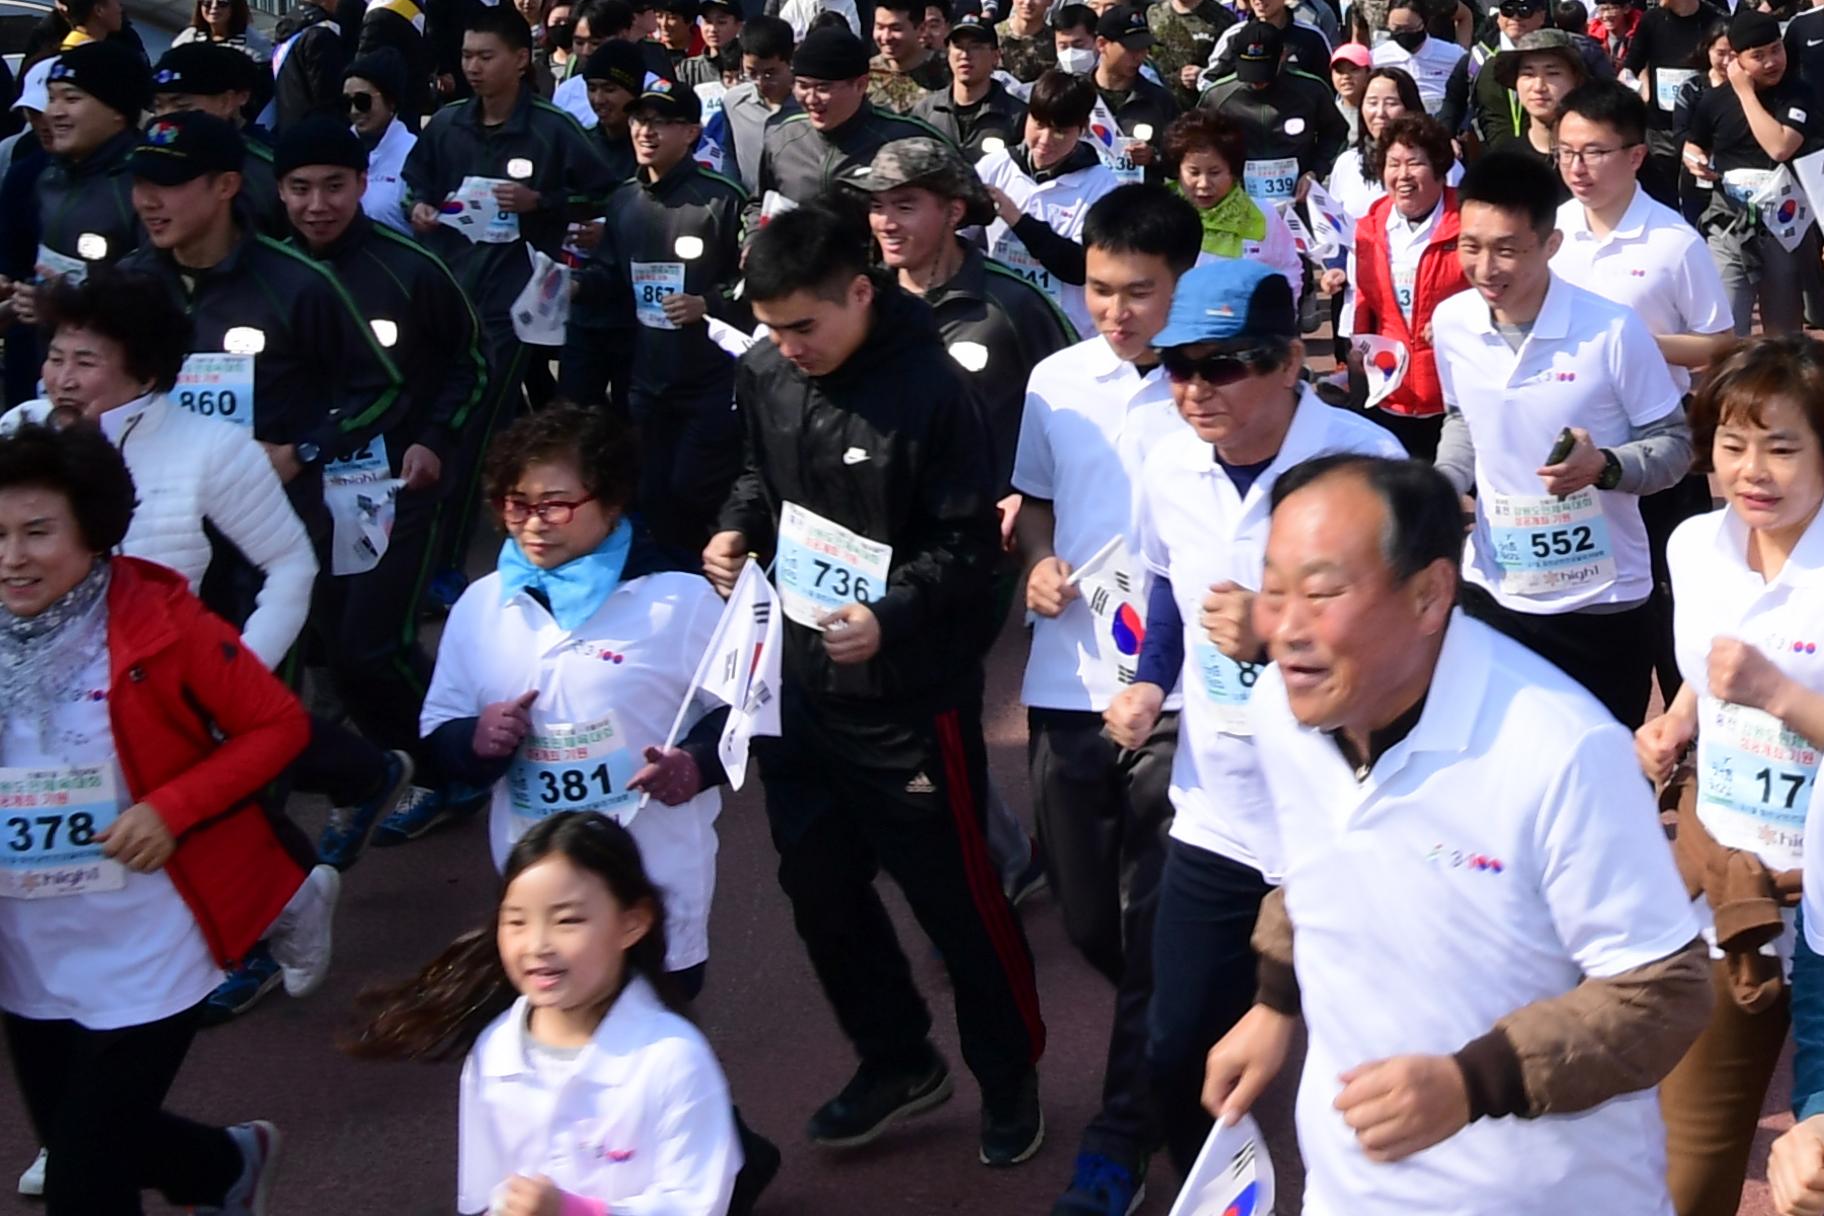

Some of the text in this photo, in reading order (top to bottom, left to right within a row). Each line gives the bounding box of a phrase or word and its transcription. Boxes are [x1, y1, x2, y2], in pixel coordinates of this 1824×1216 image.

[179, 390, 237, 416] 860
[1530, 525, 1595, 558] 552
[813, 559, 870, 603] 736
[538, 762, 612, 804] 381
[1756, 767, 1815, 809] 17
[7, 811, 95, 852] 378
